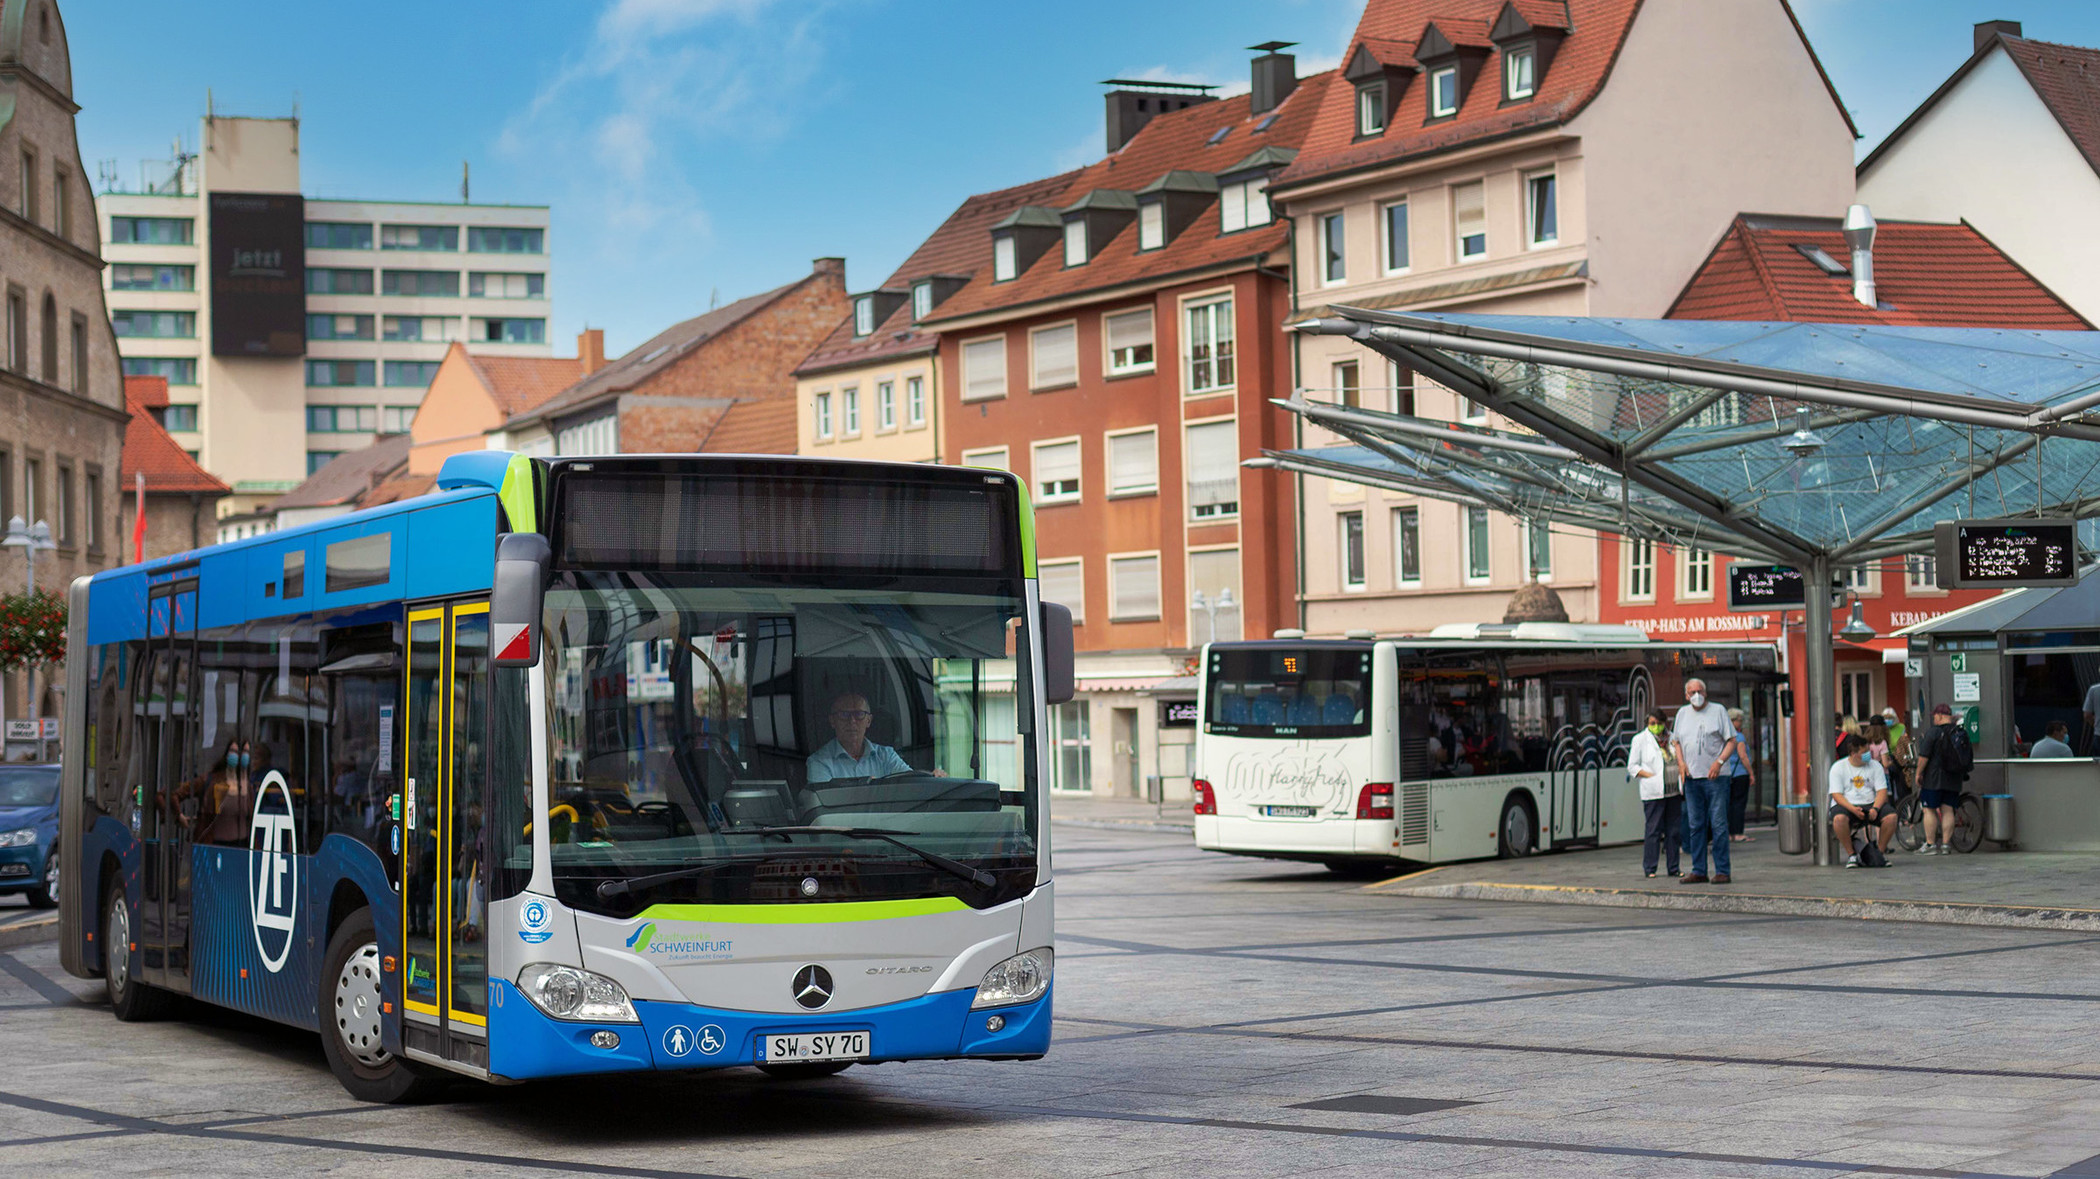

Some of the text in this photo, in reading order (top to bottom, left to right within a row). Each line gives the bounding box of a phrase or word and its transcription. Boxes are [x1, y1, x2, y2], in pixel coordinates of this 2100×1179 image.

[232, 248, 282, 269] jetzt
[1960, 527, 1968, 538] A
[1688, 617, 1705, 633] AM
[1706, 615, 1770, 632] ROSSMART
[654, 931, 712, 941] Stadtwerke
[649, 941, 733, 954] SCHWEINFURT
[865, 965, 933, 975] CITARO
[489, 982, 504, 1008] 70
[774, 1034, 863, 1057] SW SY 70
